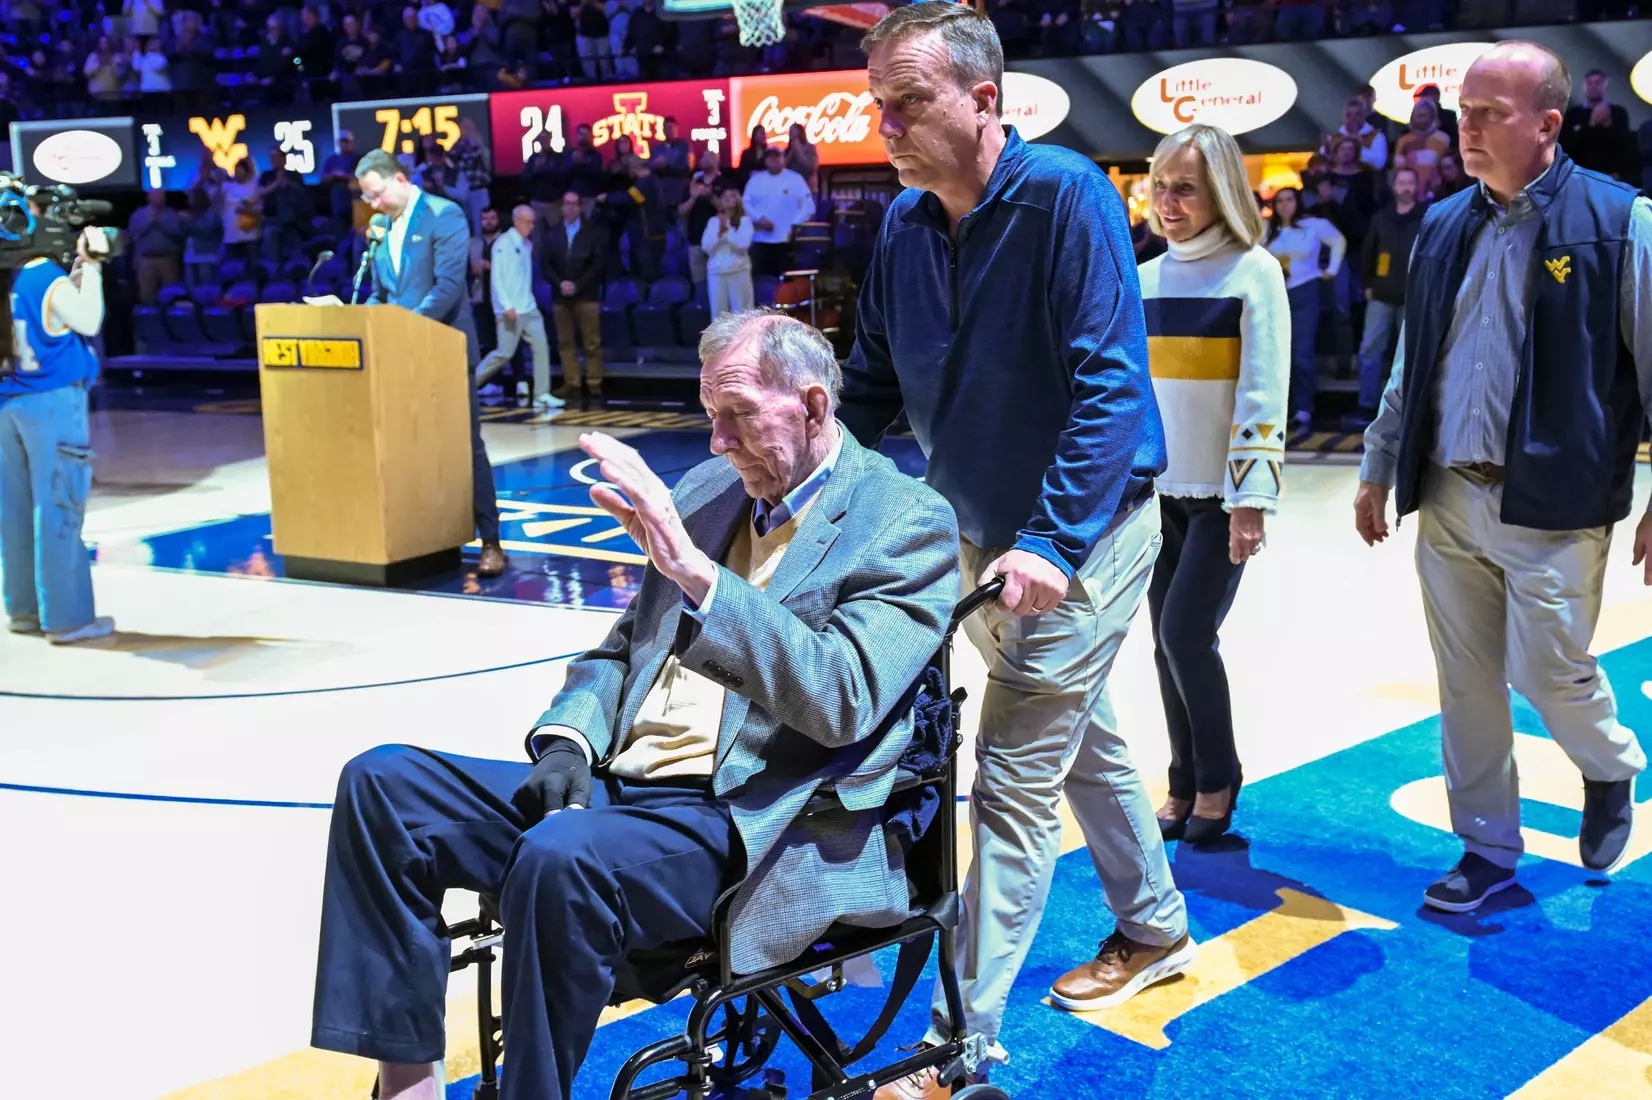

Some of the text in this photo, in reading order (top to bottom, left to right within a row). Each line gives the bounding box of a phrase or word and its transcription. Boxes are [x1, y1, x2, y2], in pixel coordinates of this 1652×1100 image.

[1161, 78, 1212, 102] Little
[1399, 64, 1457, 90] Little
[1173, 93, 1261, 124] General
[375, 105, 461, 154] 7:15
